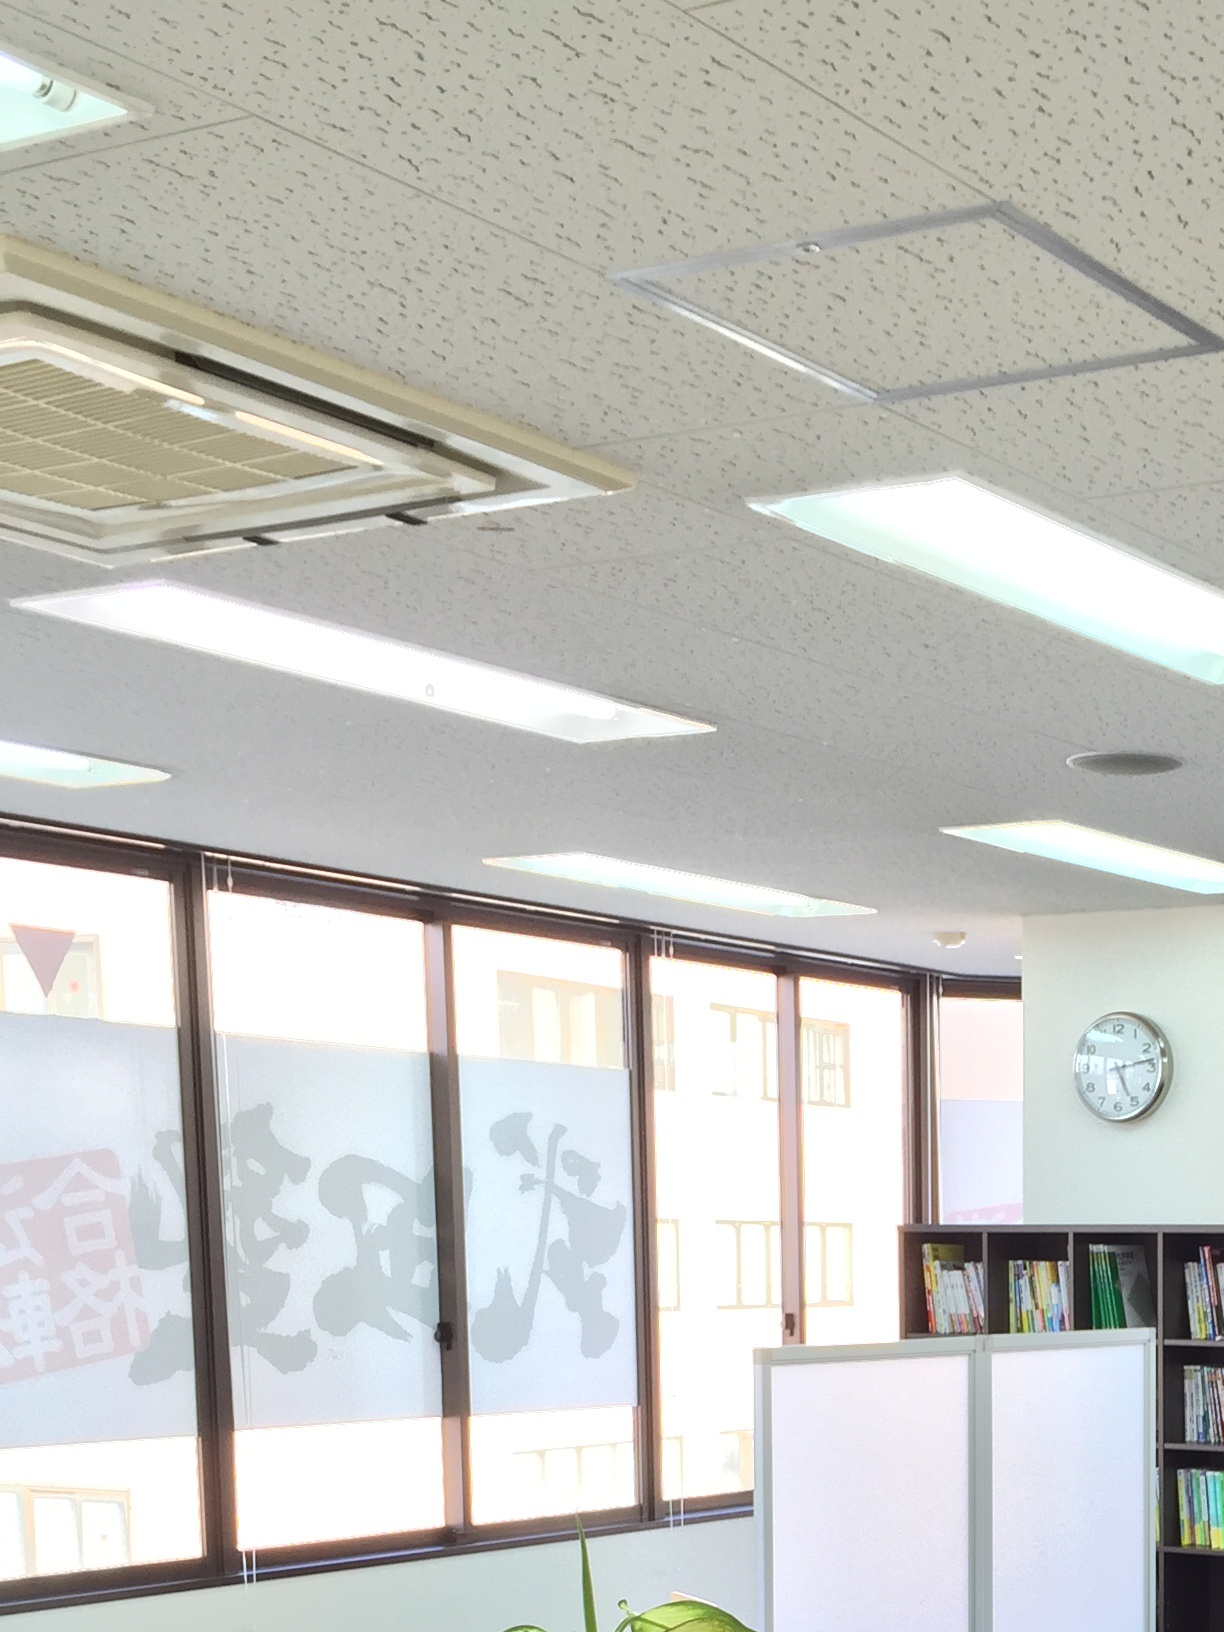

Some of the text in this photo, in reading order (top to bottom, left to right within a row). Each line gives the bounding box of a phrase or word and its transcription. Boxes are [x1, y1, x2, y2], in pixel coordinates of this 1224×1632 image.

[1112, 1023, 1125, 1035] 12
[1133, 1028, 1138, 1039] 1
[1086, 1044, 1096, 1055] 10
[1142, 1042, 1152, 1054] 2
[1081, 1063, 1090, 1074] 9
[1146, 1060, 1157, 1074] 3
[1085, 1082, 1095, 1093] 8
[1141, 1082, 1151, 1094] 4
[1097, 1096, 1106, 1107] 7
[1113, 1101, 1123, 1112] 6
[1130, 1095, 1140, 1107] 5
